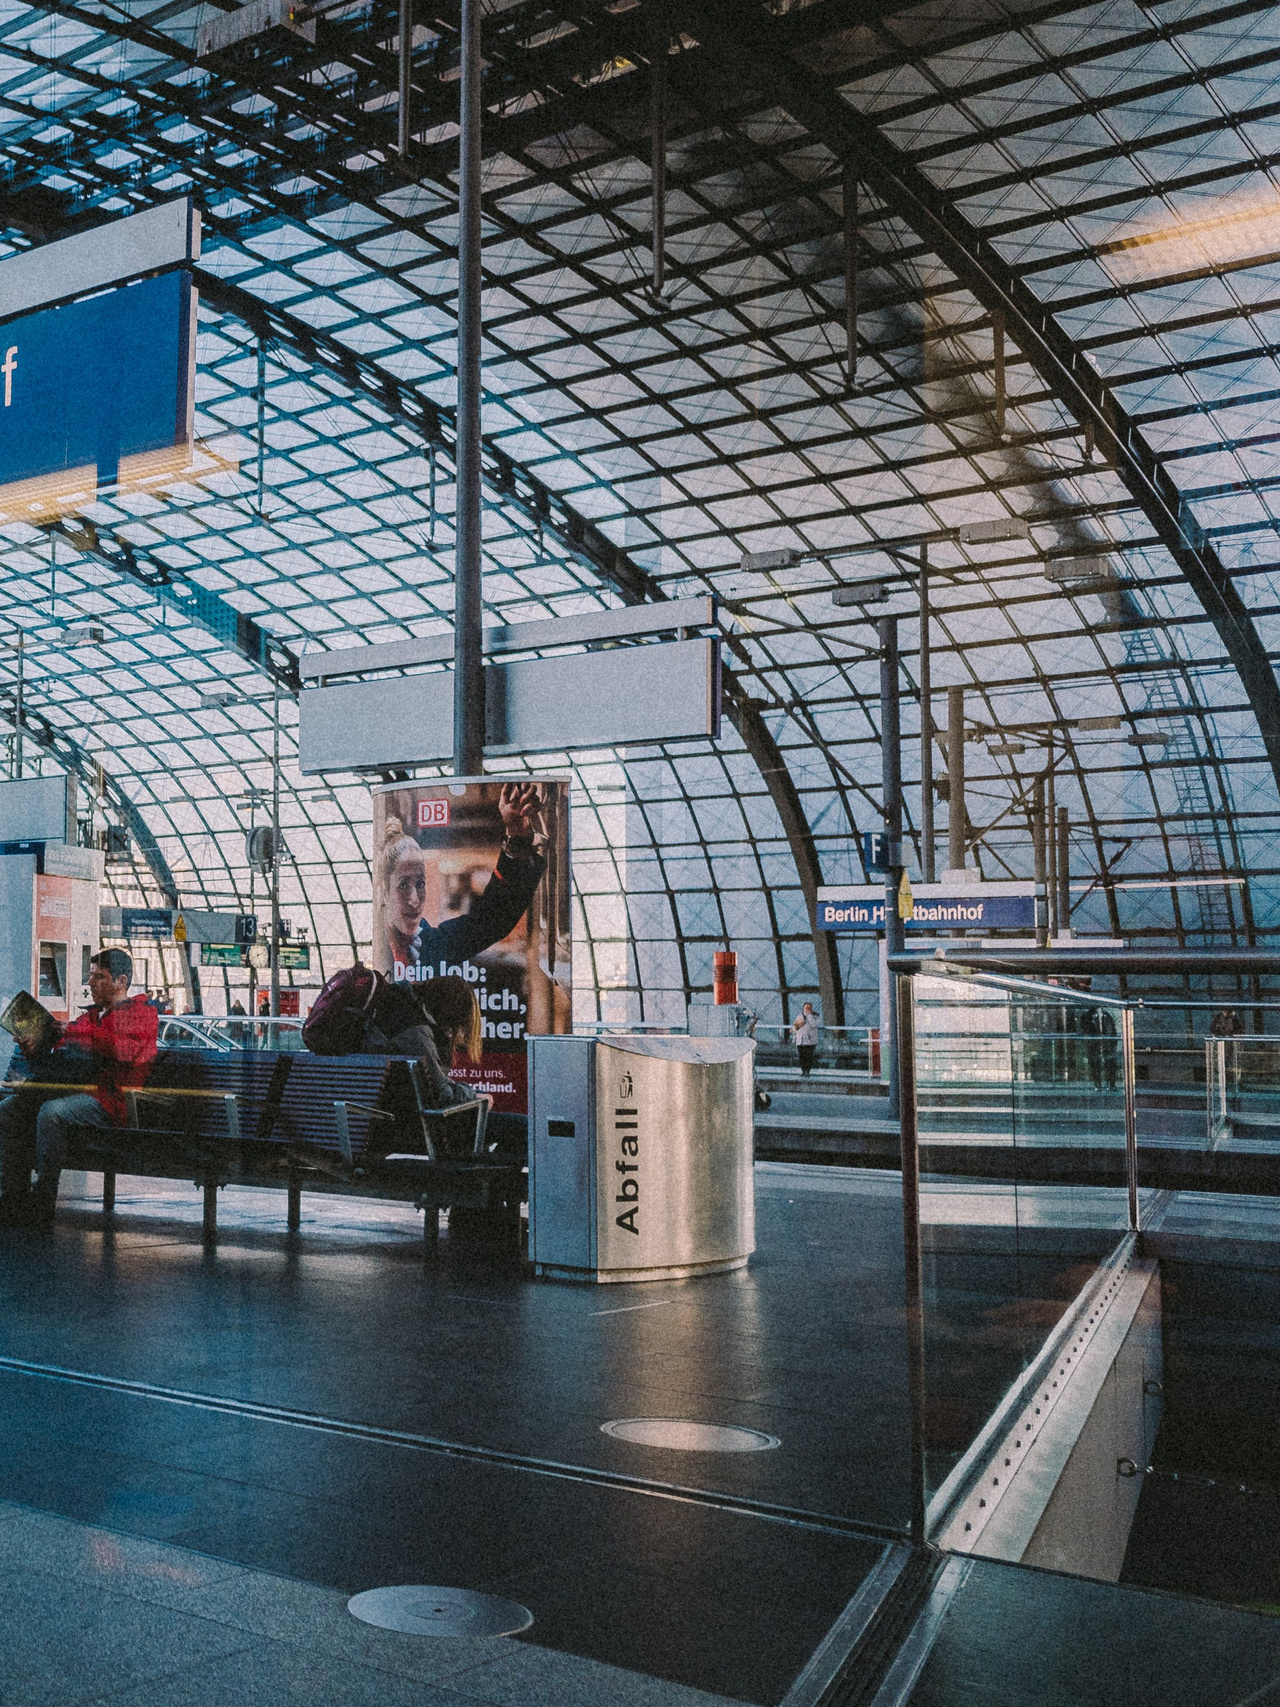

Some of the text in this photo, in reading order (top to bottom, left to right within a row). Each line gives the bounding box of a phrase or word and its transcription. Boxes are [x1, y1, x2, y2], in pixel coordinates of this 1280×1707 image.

[420, 801, 446, 823] DB
[871, 834, 881, 864] F
[824, 904, 984, 925] Berlin Htbahnhof
[240, 918, 255, 937] 13
[394, 961, 434, 982] Dein
[470, 1069, 482, 1078] zu
[484, 1069, 507, 1078] uns.
[615, 1108, 640, 1236] Abfall
